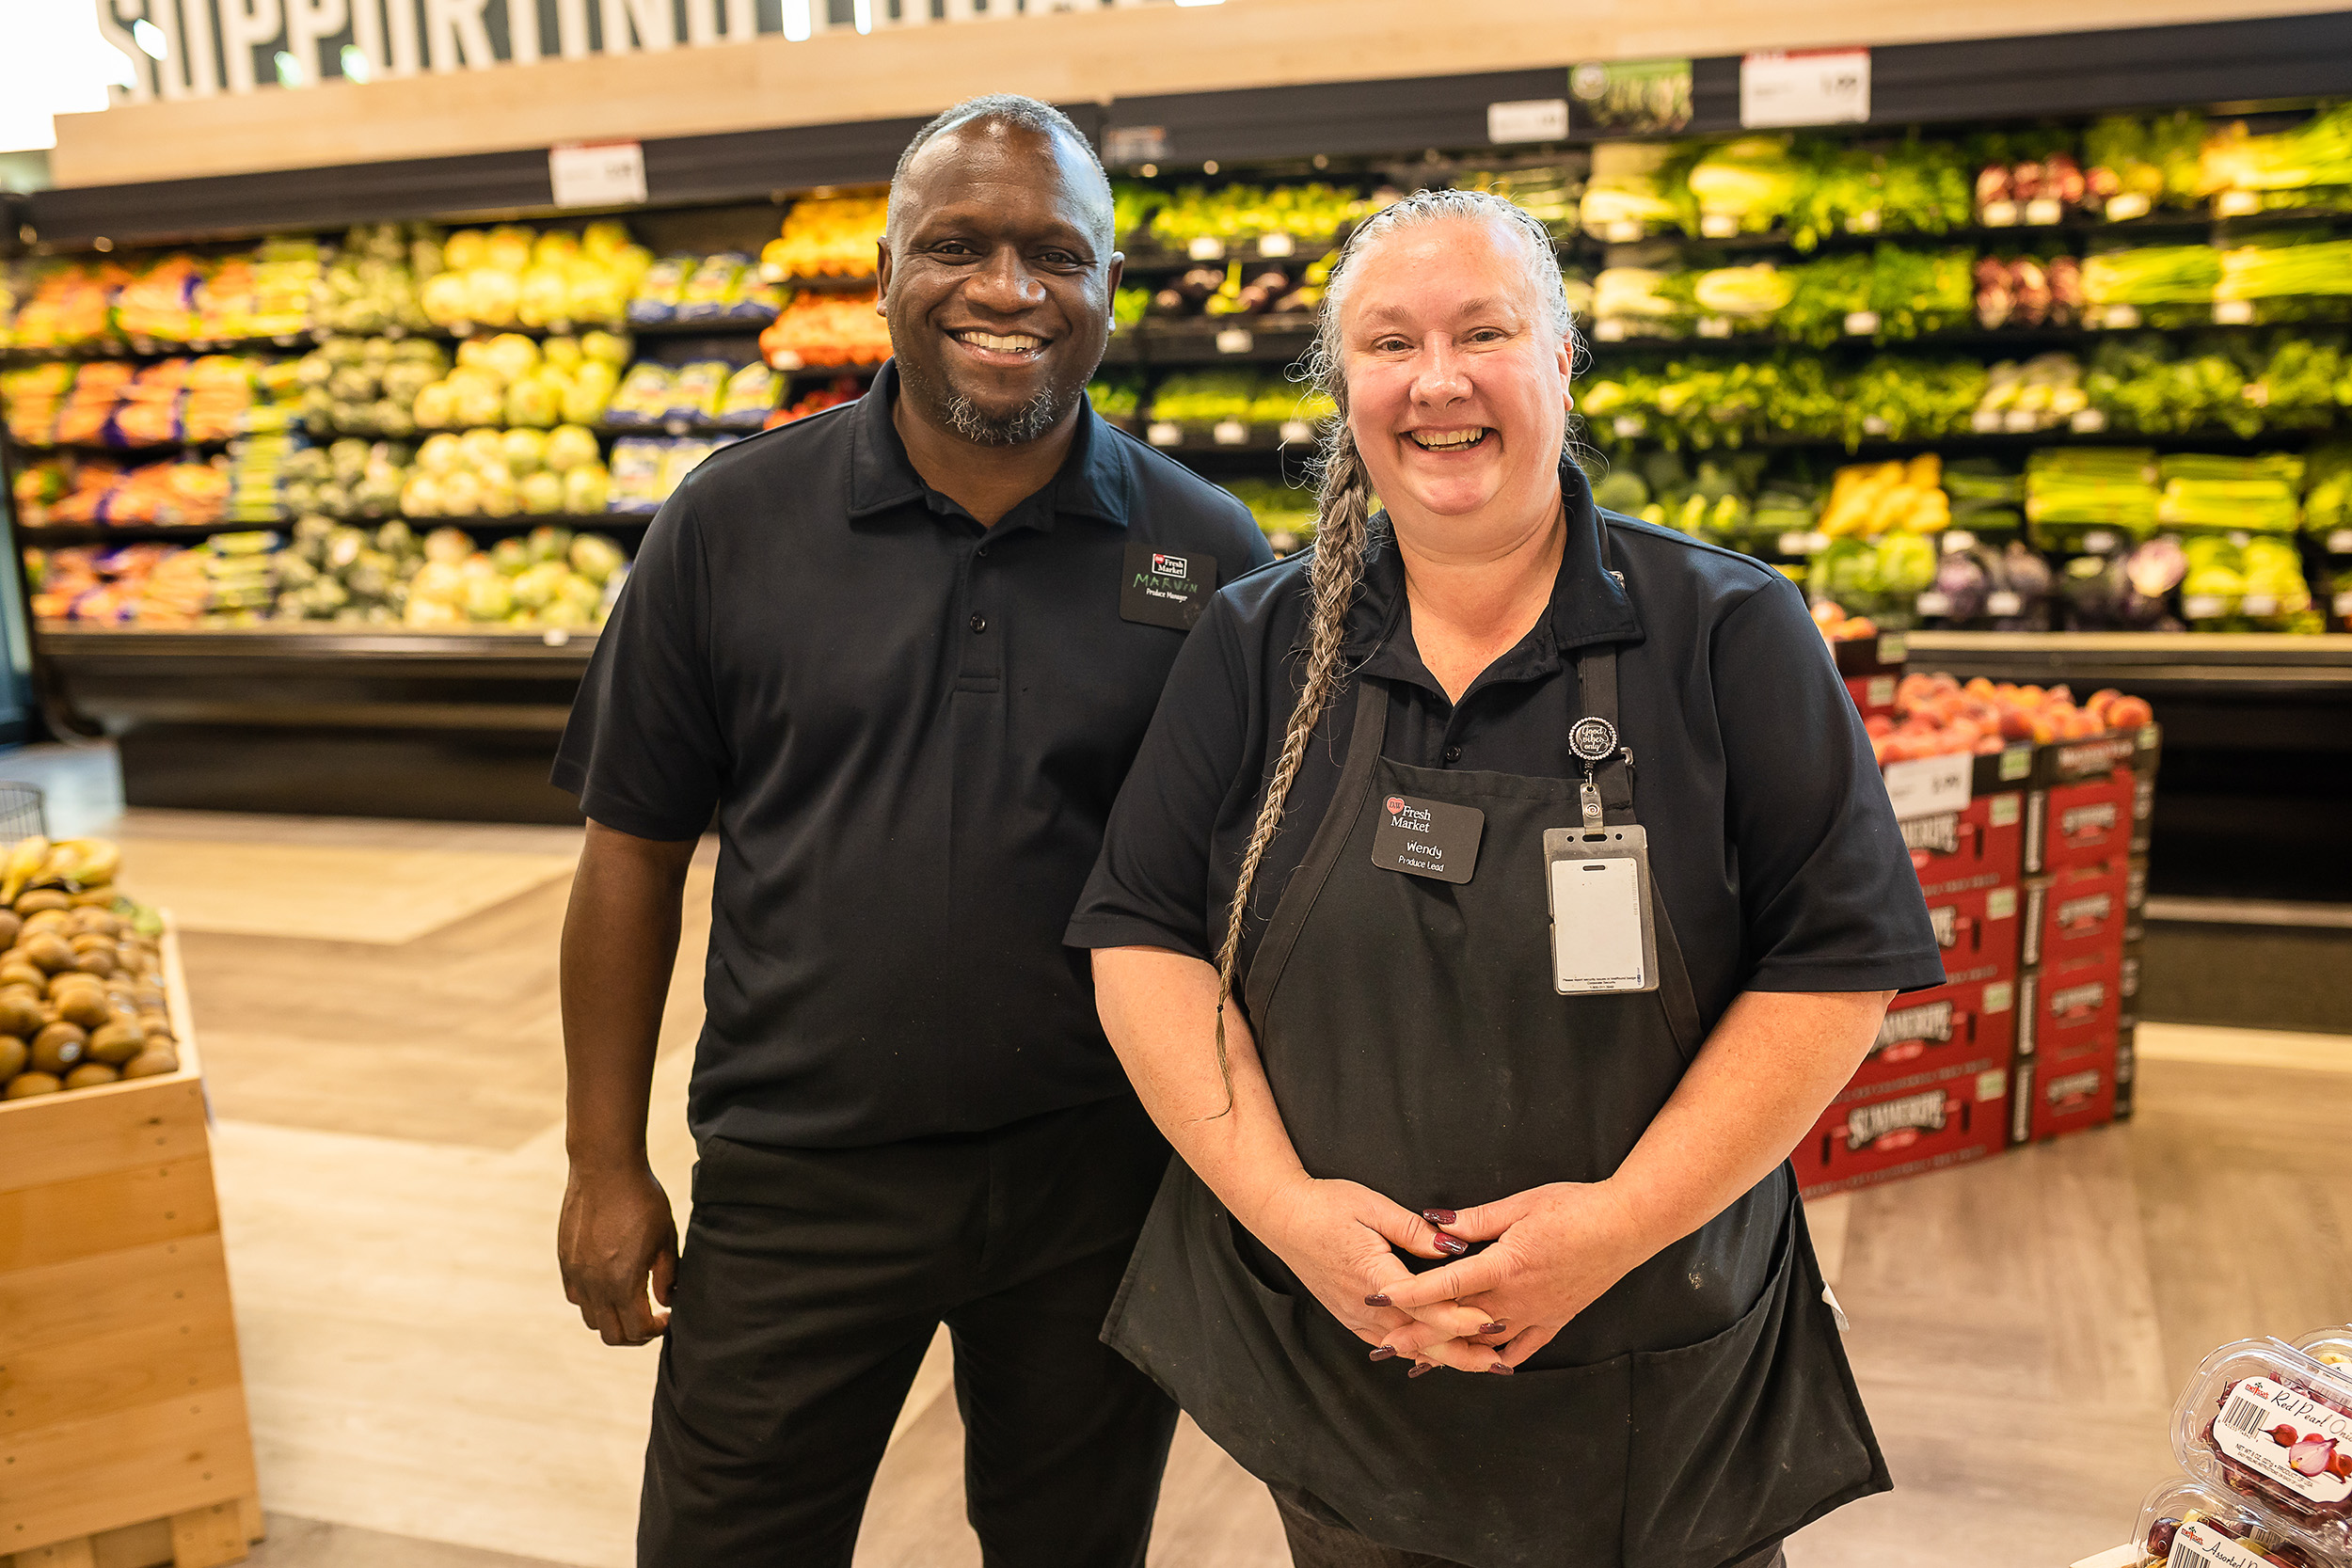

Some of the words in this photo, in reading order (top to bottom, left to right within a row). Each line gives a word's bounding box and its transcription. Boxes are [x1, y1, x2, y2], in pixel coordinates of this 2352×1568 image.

[1158, 564, 1184, 575] Market
[1165, 559, 1184, 569] Fresh
[1402, 805, 1431, 821] Fresh
[1391, 816, 1430, 833] Market
[1406, 841, 1442, 860] Wendy
[1398, 855, 1426, 869] Produce
[1426, 861, 1445, 872] Lead
[2270, 1389, 2300, 1412] Red
[2294, 1402, 2333, 1428] Pearl
[2201, 1541, 2247, 1568] Assorted
